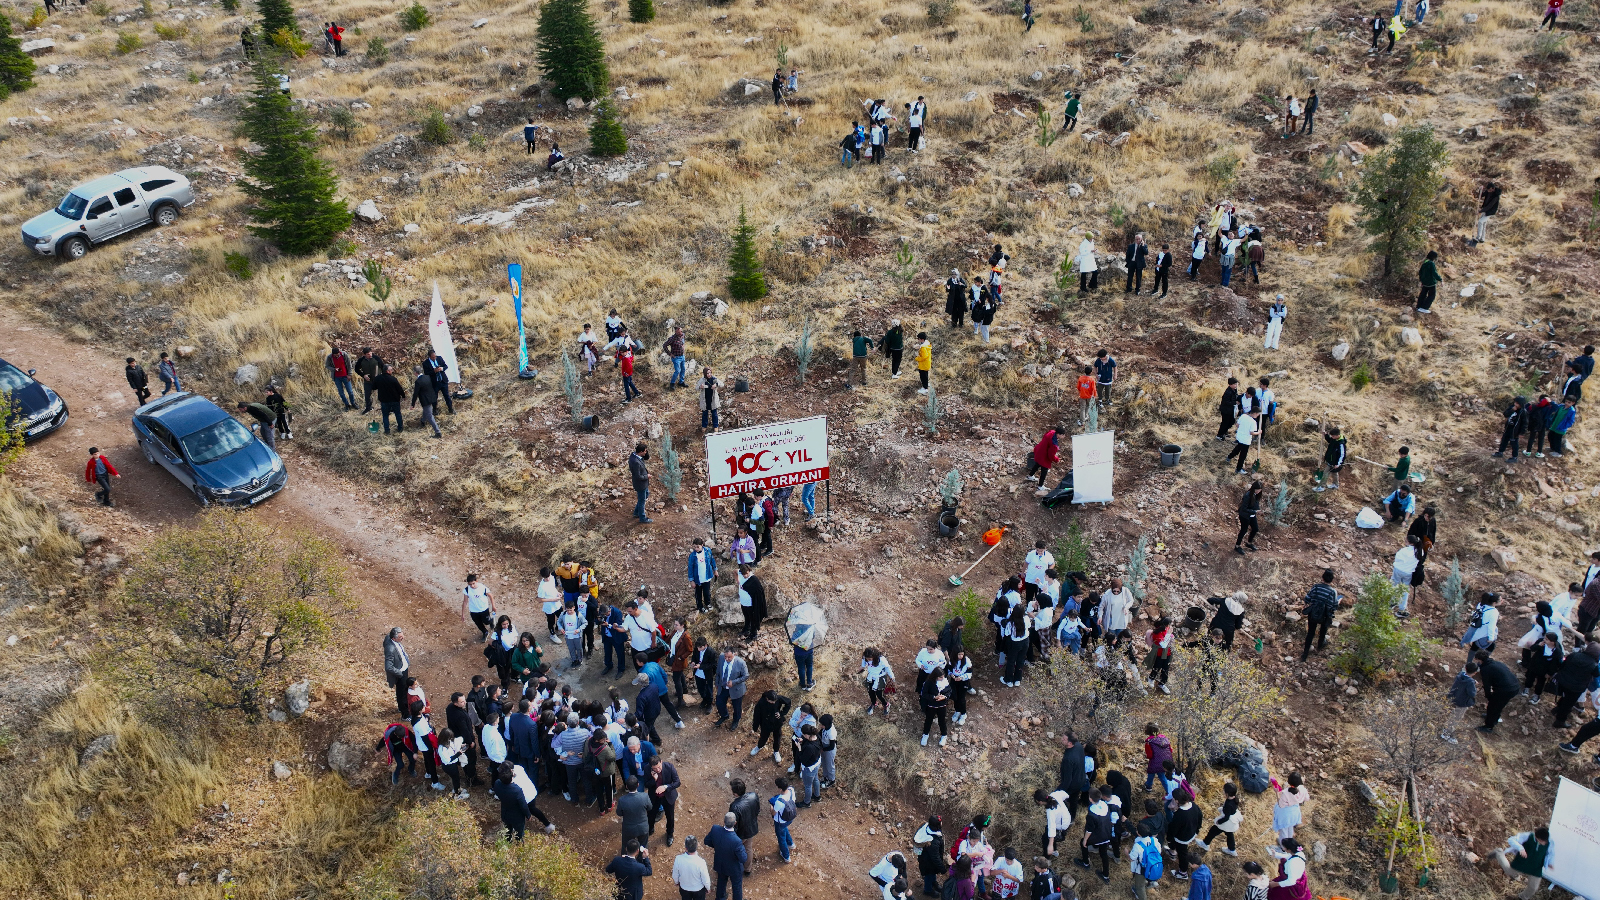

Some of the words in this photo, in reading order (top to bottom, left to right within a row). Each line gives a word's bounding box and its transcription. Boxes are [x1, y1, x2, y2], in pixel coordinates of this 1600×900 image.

[785, 449, 813, 464] YIL
[718, 481, 767, 497] HATIRA
[770, 469, 822, 486] ORMANI
